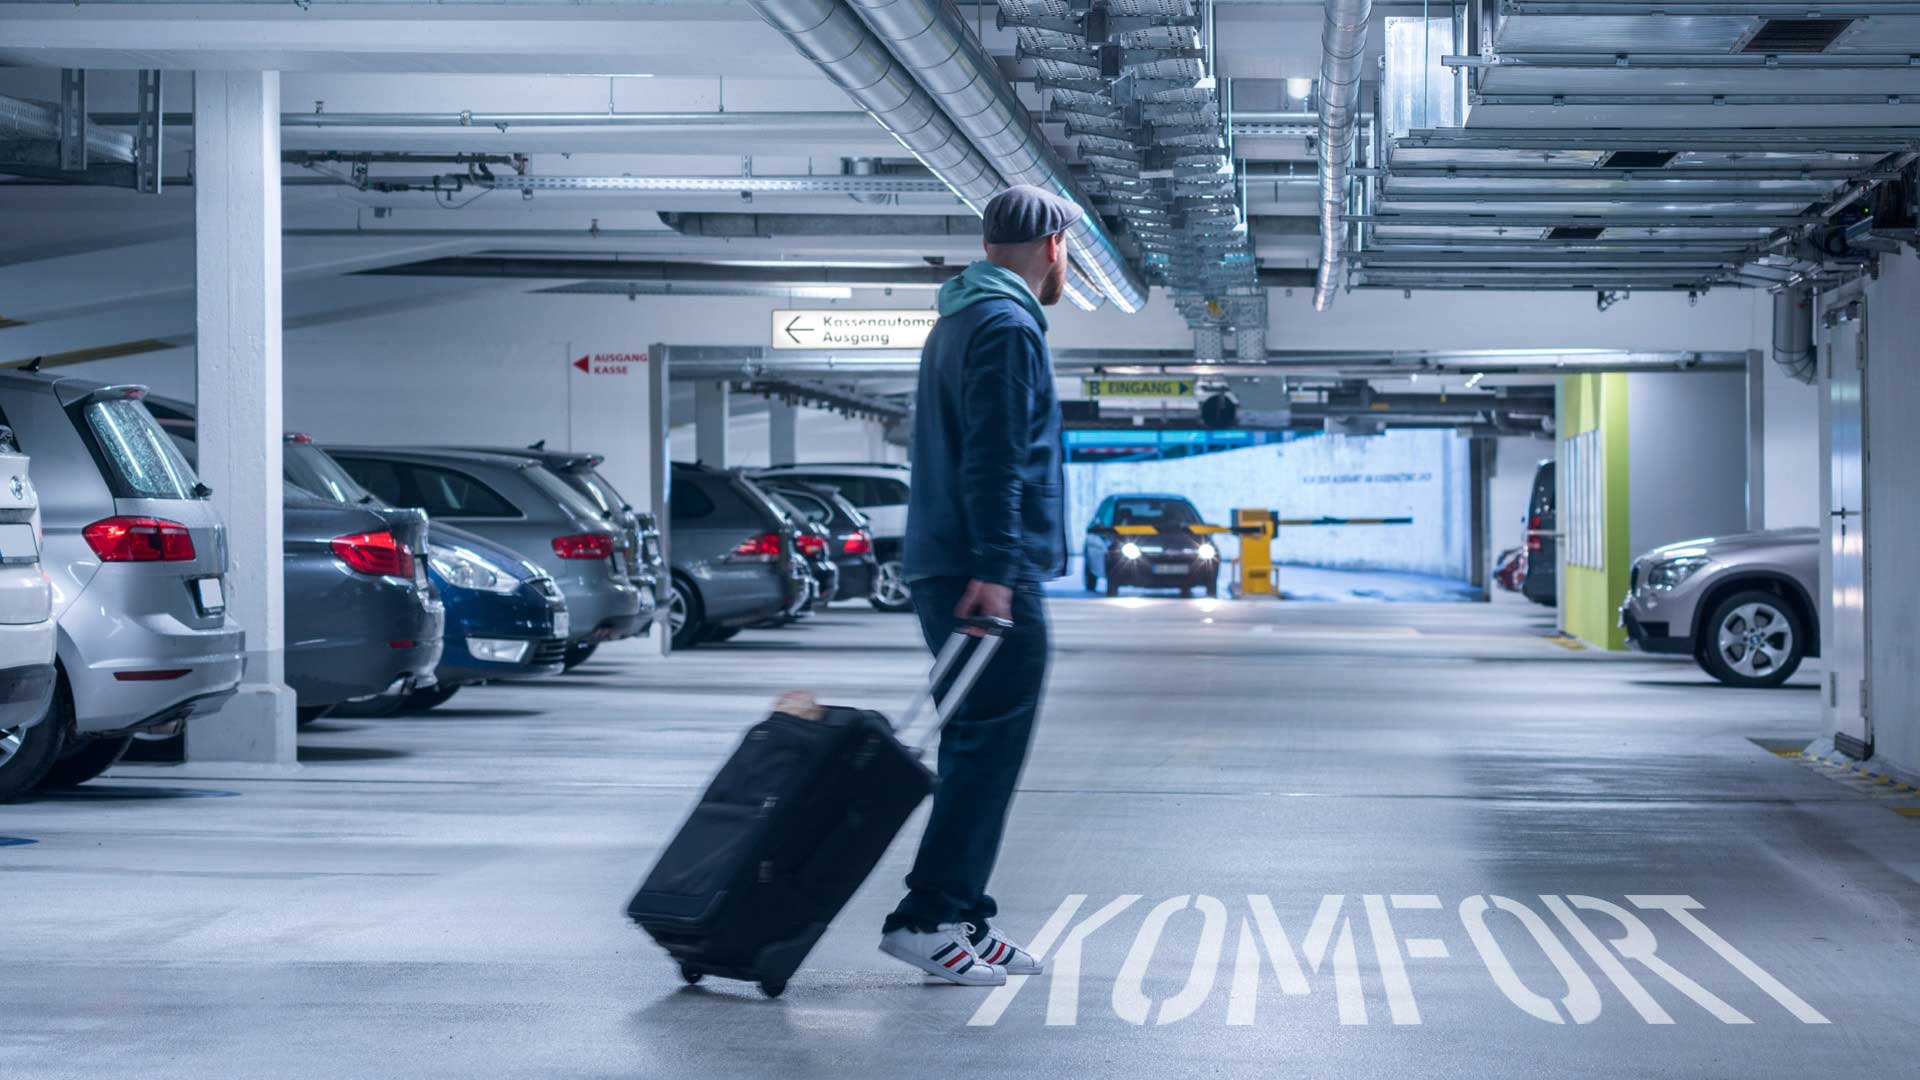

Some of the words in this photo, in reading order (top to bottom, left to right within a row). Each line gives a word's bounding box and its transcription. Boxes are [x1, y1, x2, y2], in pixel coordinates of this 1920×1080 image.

[822, 331, 890, 346] Ausgang
[594, 353, 648, 362] AUSGANG
[594, 366, 628, 375] KASSE
[1108, 381, 1172, 394] EINGANG
[966, 894, 1832, 1027] KOMFORT
